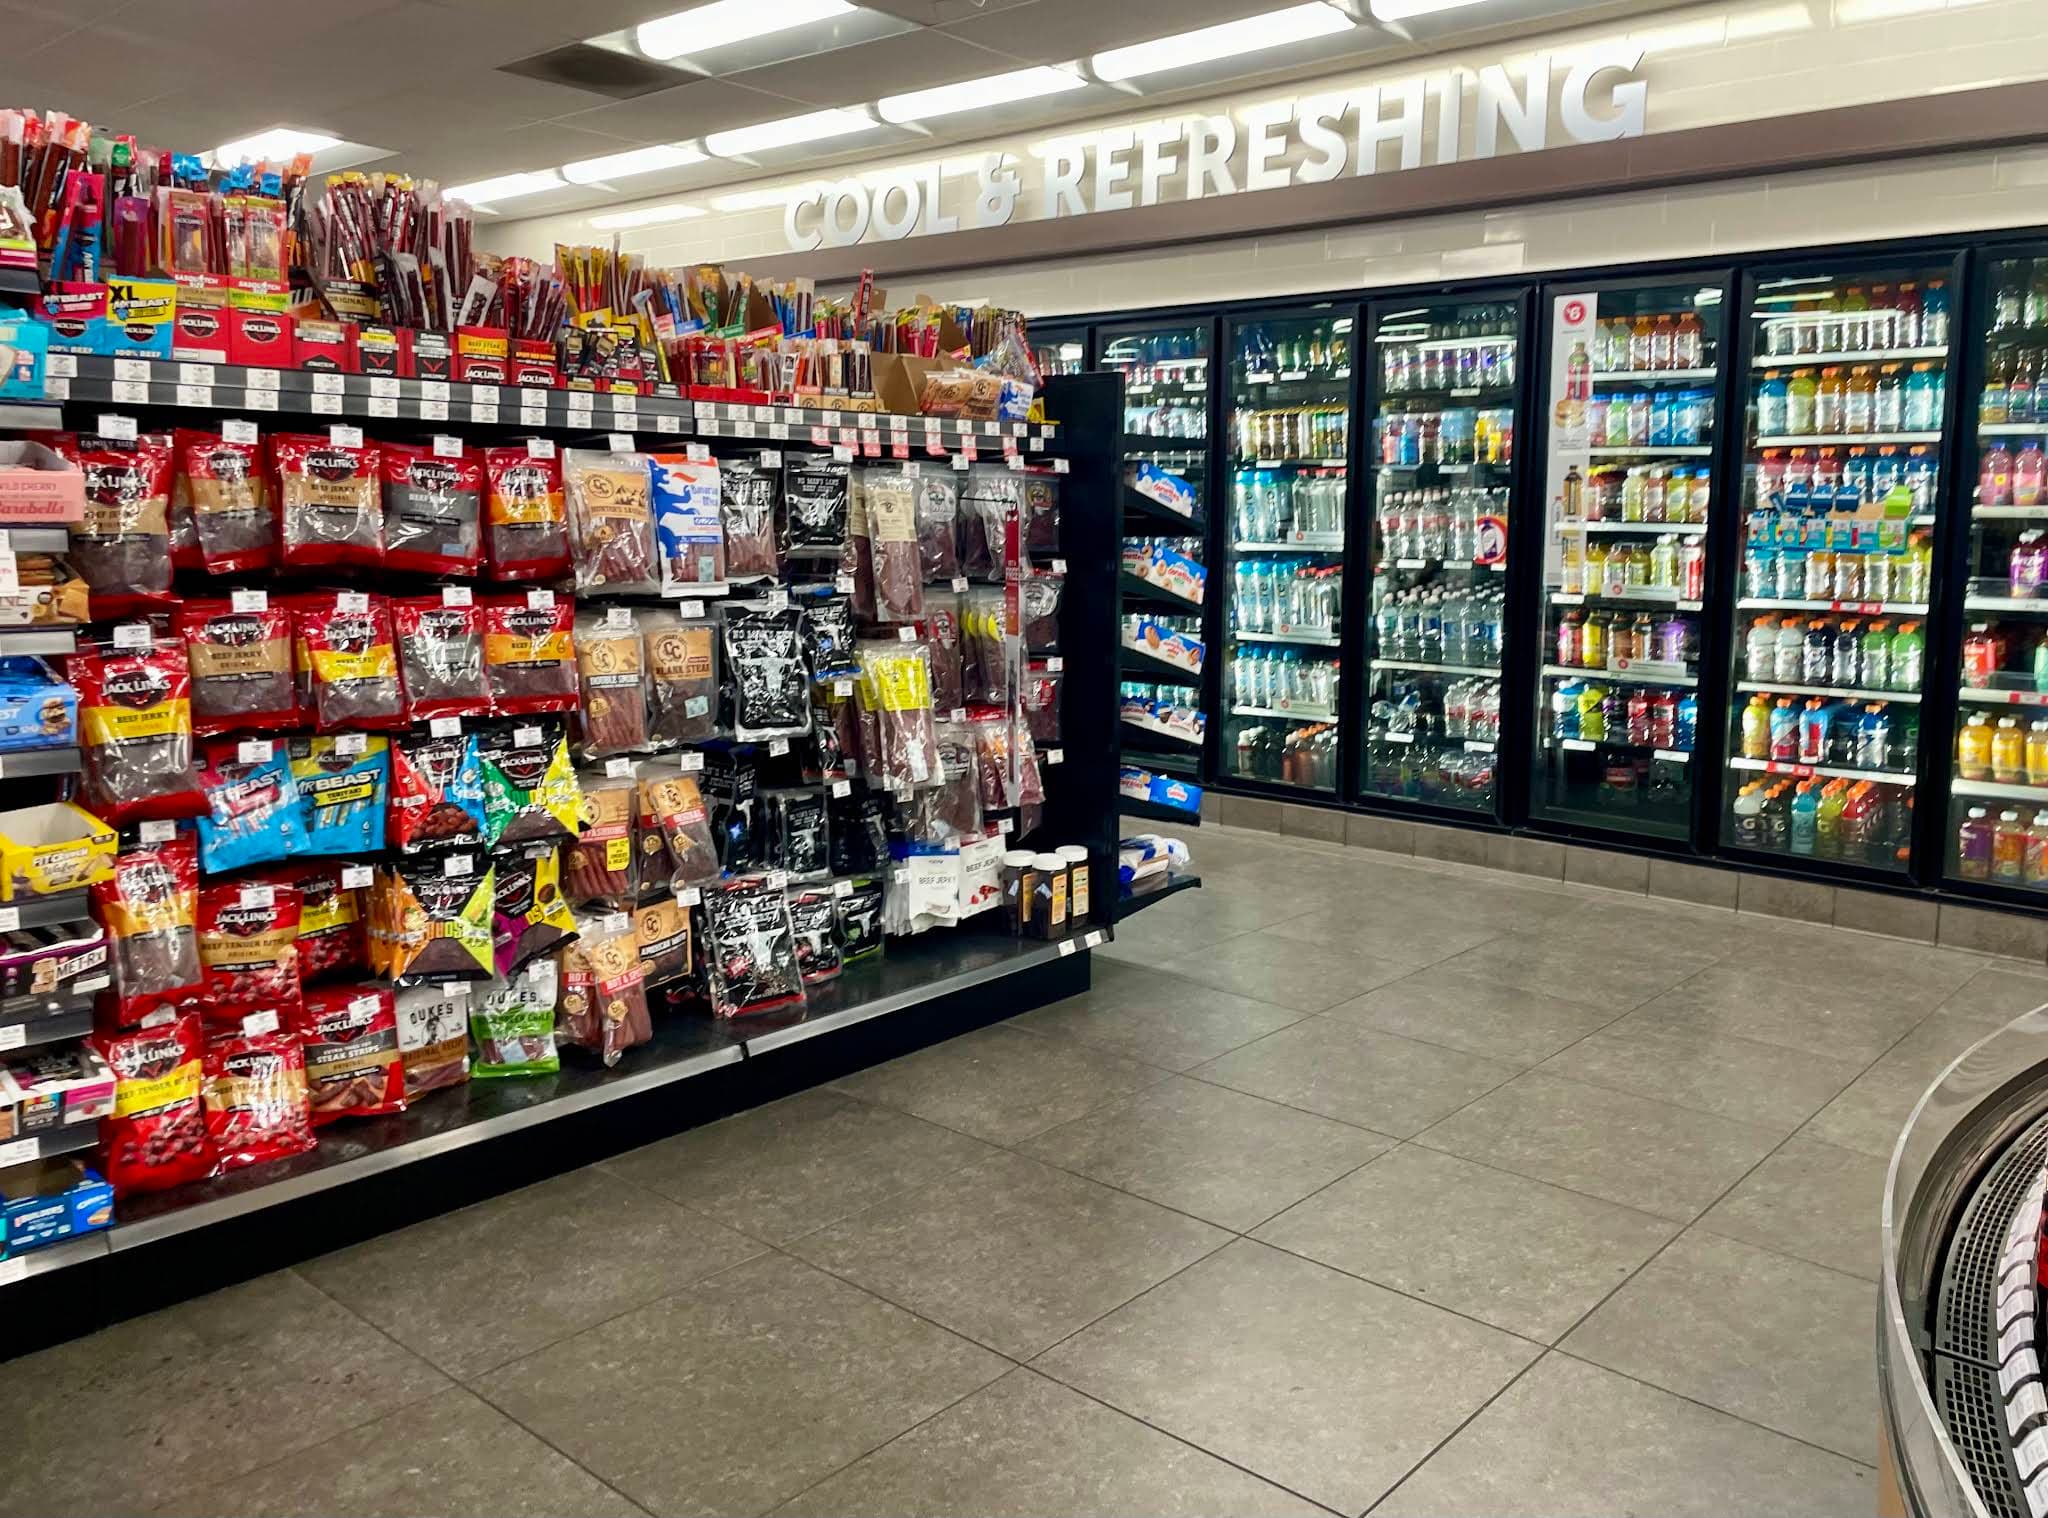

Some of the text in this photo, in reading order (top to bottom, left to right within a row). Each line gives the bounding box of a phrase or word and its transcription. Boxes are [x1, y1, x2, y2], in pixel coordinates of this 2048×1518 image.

[784, 50, 1648, 251] COOL & REFRESHING
[110, 286, 139, 302] XL
[80, 440, 114, 449] FAMILY
[117, 715, 139, 723] BEEF
[316, 1052, 347, 1064] STEAK
[348, 1044, 380, 1058] STRIPS
